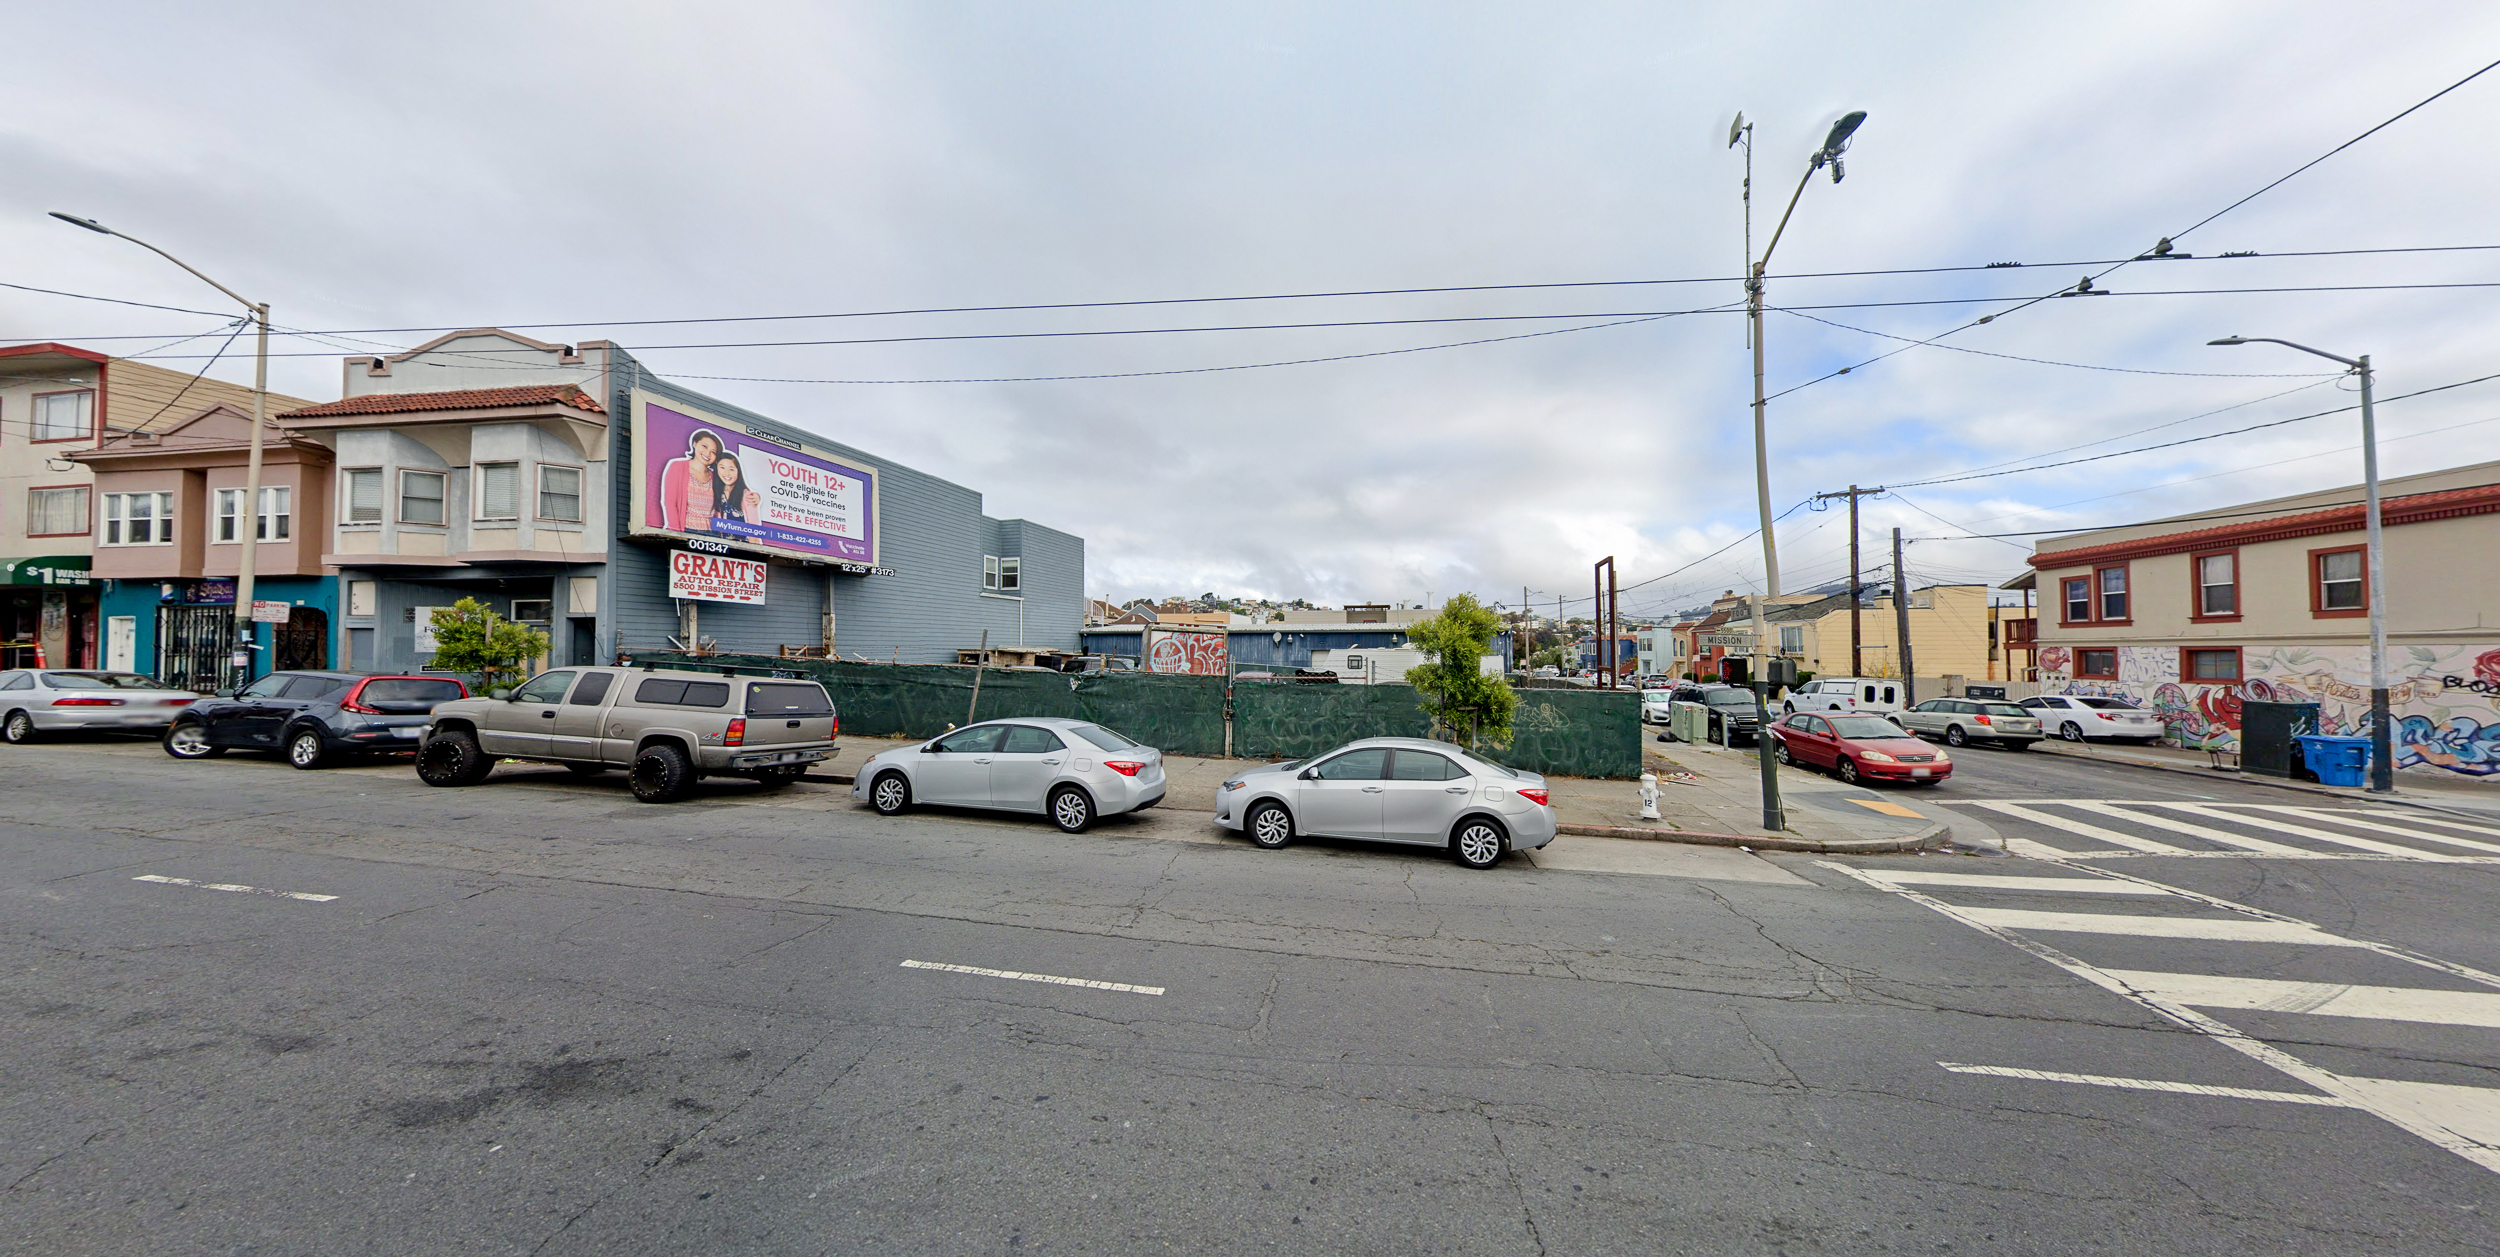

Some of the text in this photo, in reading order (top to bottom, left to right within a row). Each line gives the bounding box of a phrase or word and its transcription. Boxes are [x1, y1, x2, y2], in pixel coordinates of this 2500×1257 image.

[768, 458, 846, 491] YOUTH 12+
[770, 485, 846, 511] COVID-19 vaccines
[779, 480, 838, 499] are eligible for
[770, 500, 846, 523] They have been proven
[770, 508, 846, 533] SAFE & EFFECTIVE
[716, 521, 822, 546] MyTurn.ca.gov 1-833-422-4255
[689, 539, 729, 554] 001347
[26, 566, 89, 584] $1 WASH
[673, 553, 765, 583] GRANT'S
[870, 567, 895, 577] #3173
[673, 582, 764, 597] 5500 MISSION STREET
[678, 575, 760, 590] AUTO REPAIR
[1732, 608, 1752, 618] FOOTE
[1707, 636, 1742, 645] MISSION
[1644, 799, 1653, 807] 12
